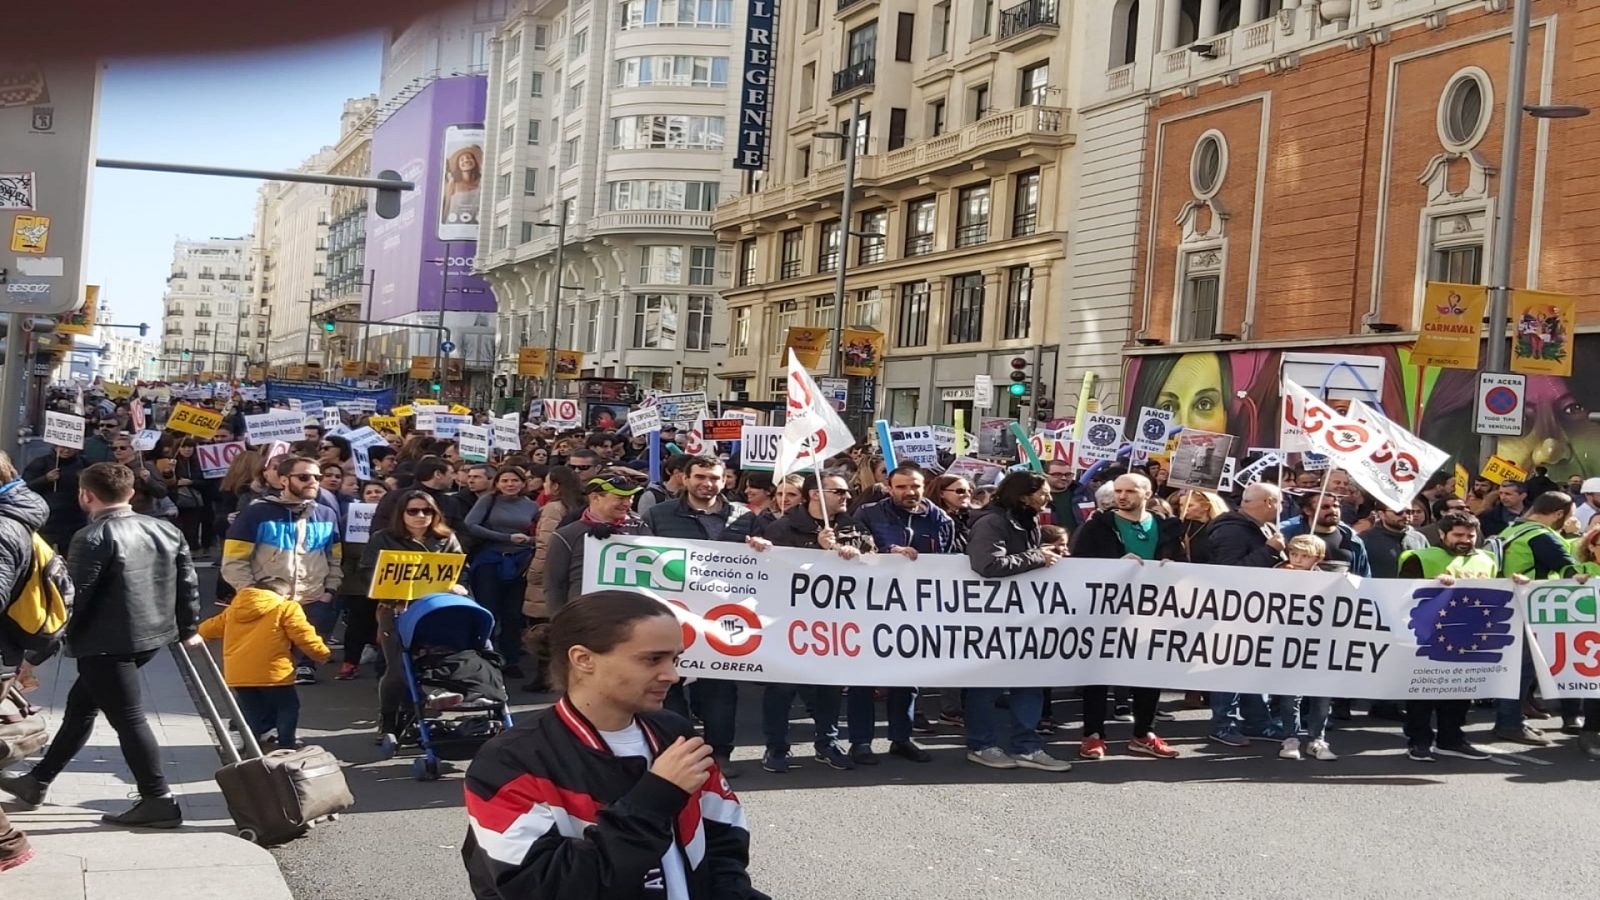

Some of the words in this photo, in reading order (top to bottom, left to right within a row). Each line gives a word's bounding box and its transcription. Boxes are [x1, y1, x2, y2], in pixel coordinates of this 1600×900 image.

[742, 28, 770, 166] REGENTE
[1424, 323, 1475, 334] CARNAVAL
[544, 400, 576, 420] NO
[1144, 410, 1170, 420] AÑOS
[172, 410, 190, 421] ¡ES
[190, 414, 220, 430] ILEGAL!
[1090, 415, 1121, 426] AÑOS
[1094, 430, 1108, 440] 21
[1148, 424, 1160, 434] 21
[198, 443, 243, 470] NO
[690, 551, 757, 565] Federación
[378, 562, 433, 585] ¡FIJEZA,
[437, 564, 460, 581] YA!
[690, 566, 741, 580] Atención
[757, 570, 768, 580] la
[689, 582, 757, 595] Ciudadanía
[790, 572, 856, 610] POR
[866, 577, 907, 611] LA
[917, 578, 1024, 614] FIJEZA
[1030, 581, 1076, 614] YA.
[1085, 582, 1325, 626] TRABAJADORES
[1332, 596, 1391, 631] DEL
[788, 619, 861, 657] CSIC
[873, 623, 1095, 660] CONTRATADOS
[1099, 627, 1138, 659] EN
[1147, 629, 1274, 668] FRAUDE
[1282, 636, 1320, 670] DE
[1328, 639, 1390, 673] LEY
[710, 661, 763, 672] OBRERA
[1413, 666, 1451, 675] colectivo
[1453, 666, 1463, 674] de
[1465, 665, 1508, 675] emplead@s
[1411, 676, 1448, 685] públic@s
[1408, 685, 1420, 693] de
[1422, 685, 1476, 694] temporalidad
